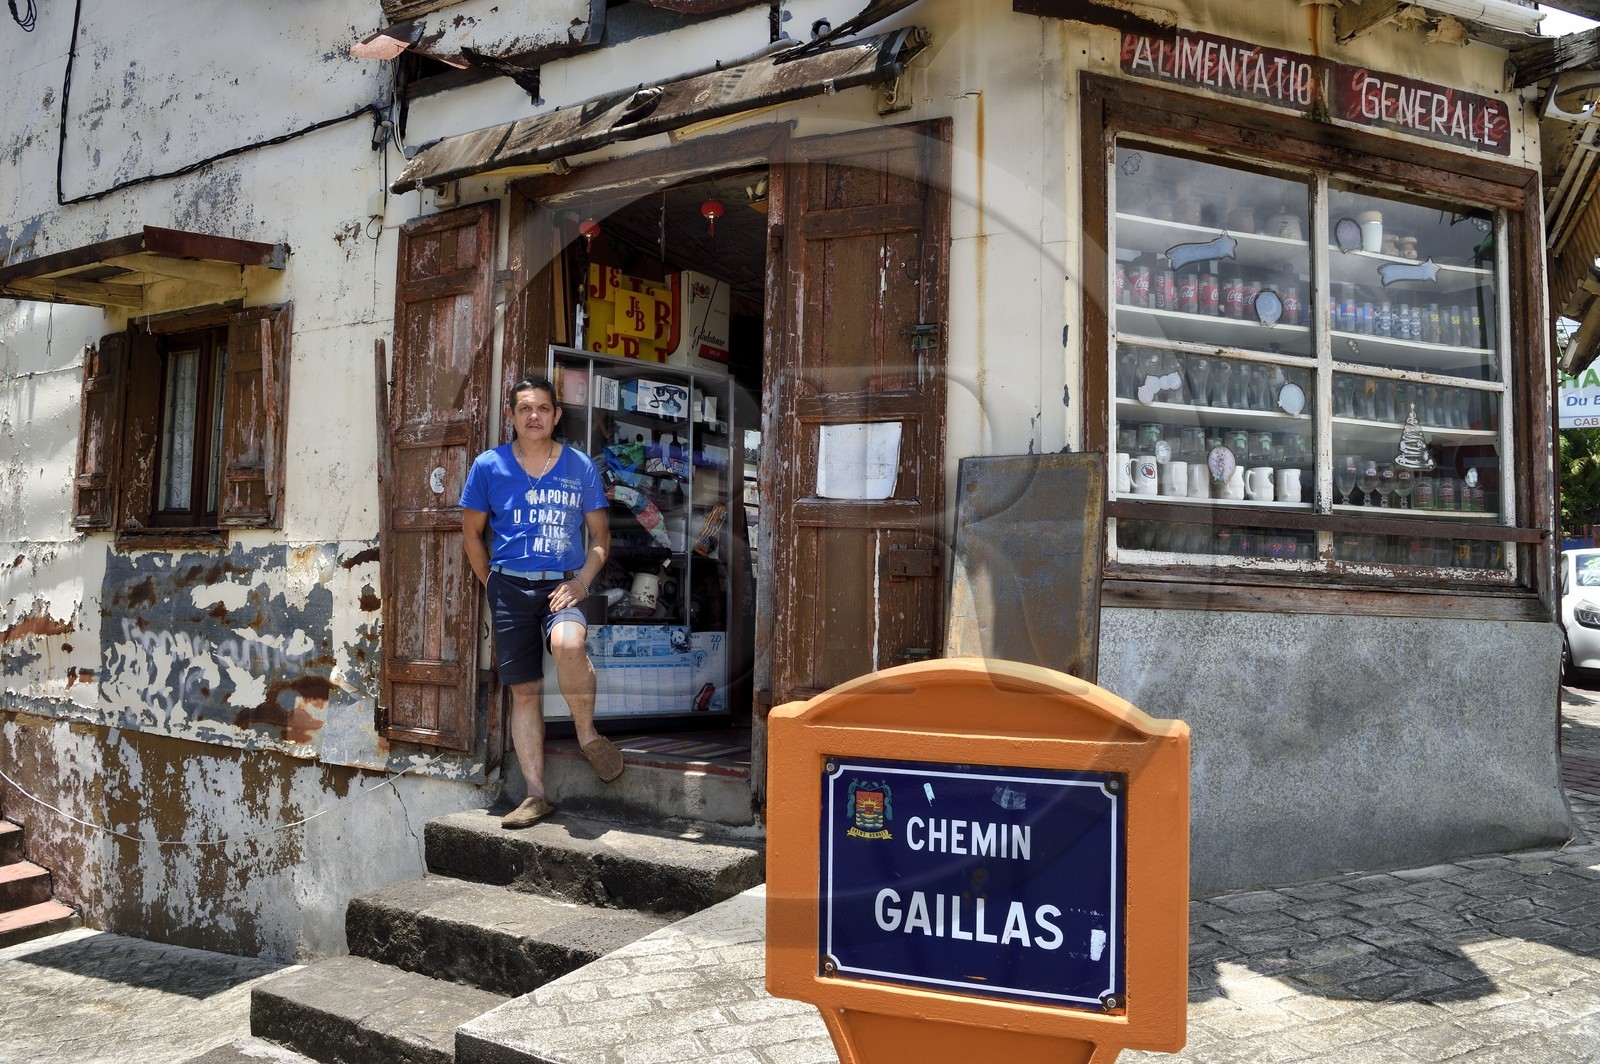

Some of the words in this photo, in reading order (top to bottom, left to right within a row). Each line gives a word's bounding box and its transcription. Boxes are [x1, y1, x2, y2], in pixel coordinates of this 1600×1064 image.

[1360, 76, 1499, 147] GENERALE
[1566, 396, 1588, 407] Du
[1573, 418, 1599, 427] CAB
[529, 509, 567, 526] CRAZY
[542, 524, 565, 539] LIKE
[906, 815, 1032, 862] CHEMIN
[874, 887, 1065, 951] GAILLAS
